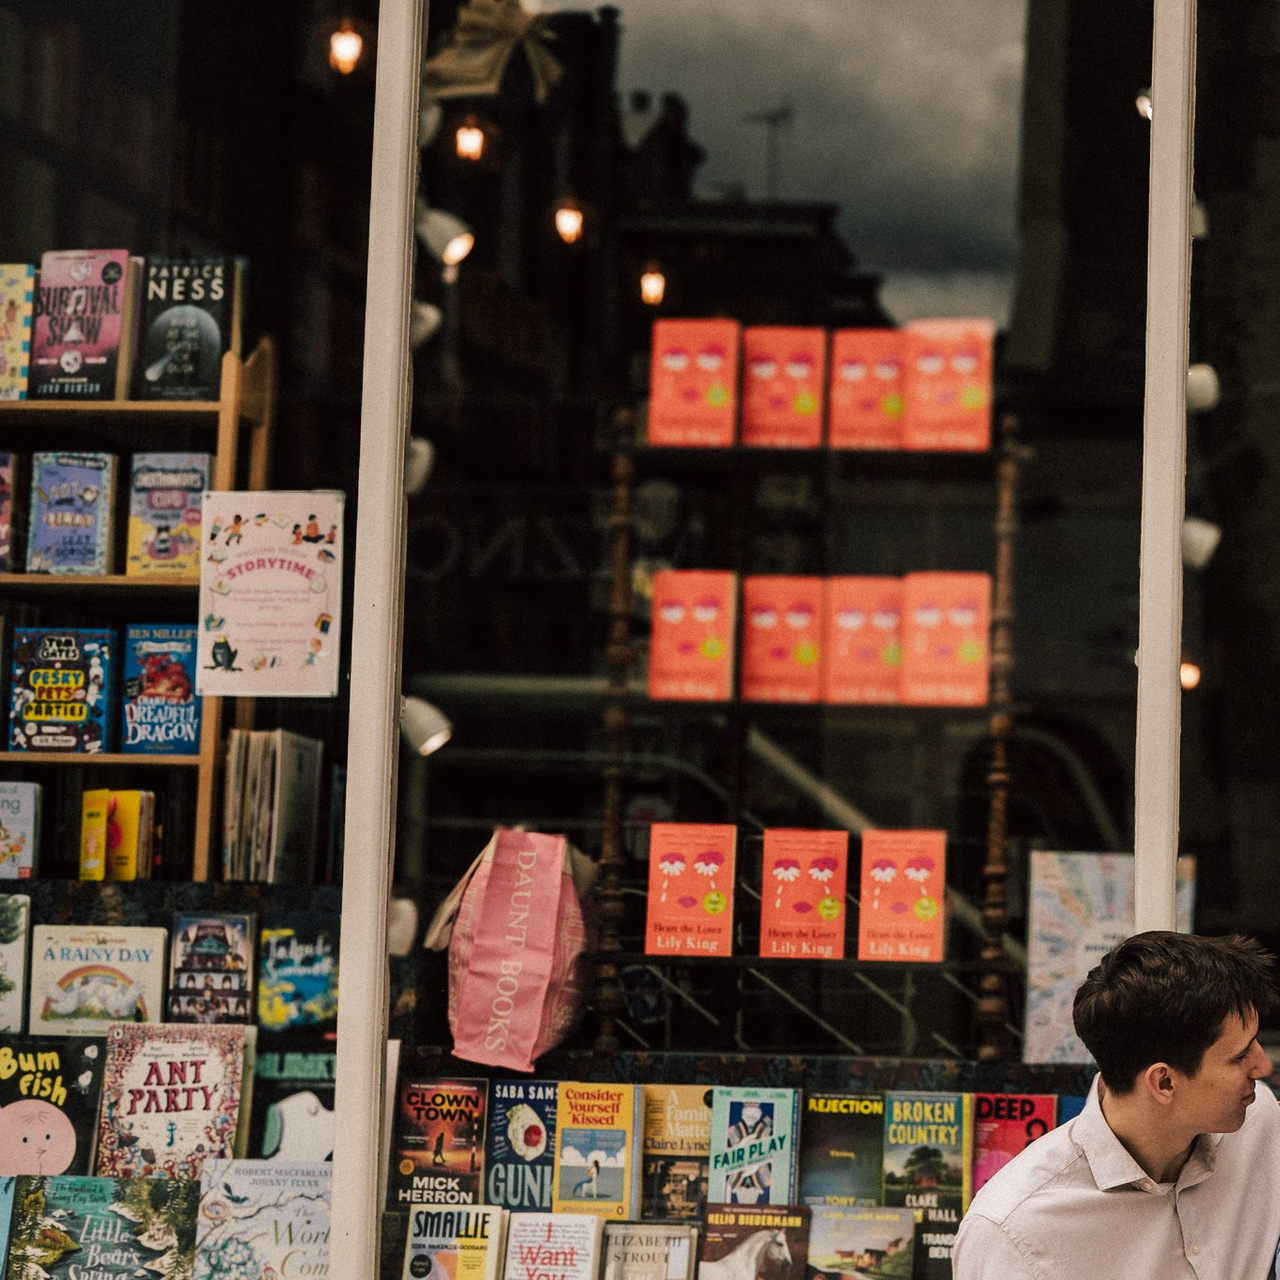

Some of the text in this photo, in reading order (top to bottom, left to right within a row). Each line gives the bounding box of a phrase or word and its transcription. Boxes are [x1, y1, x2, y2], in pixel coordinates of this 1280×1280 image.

[149, 265, 224, 278] PATRICK
[148, 278, 225, 301] NESS
[225, 558, 315, 580] STORYTIME
[41, 647, 77, 659] GATES
[32, 671, 82, 685] PESKY
[37, 686, 75, 700] PETS
[24, 704, 85, 718] PARTIES
[125, 703, 196, 723] DREADFUL
[126, 719, 199, 745] DRAGON
[484, 851, 538, 1053] DAUNT BOOKS
[657, 935, 718, 954] Lily King
[771, 941, 833, 958] Lily King
[869, 941, 931, 959] Lily King
[44, 946, 153, 963] A RAINY DAY
[0, 1046, 61, 1080] Bum
[144, 1060, 206, 1087] ANT
[406, 1091, 480, 1109] CLOWN
[495, 1084, 525, 1099] SABA
[565, 1089, 624, 1102] Consider
[668, 1089, 679, 1106] A
[127, 1086, 217, 1116] PARTY
[568, 1101, 621, 1114] Yourself
[808, 1098, 884, 1115] REJECTION
[975, 1096, 1035, 1120] DEEP
[413, 1107, 474, 1123] TOWN
[571, 1113, 616, 1126] Kissed
[892, 1101, 956, 1122] BROKEN
[643, 1137, 677, 1150] Claire
[888, 1124, 960, 1146] COUNTRY
[713, 1147, 745, 1170] FAIR
[748, 1134, 787, 1159] PLAY
[234, 1168, 272, 1176] ROBERT
[250, 1178, 320, 1187] JOHNNY FLYNN
[412, 1176, 460, 1190] MICK
[398, 1189, 473, 1204] HERRON
[824, 1195, 856, 1206] TONY
[905, 1193, 938, 1208] CLARE
[295, 1207, 316, 1218] The
[707, 1213, 802, 1228] NELIO BIEDERMANN
[928, 1208, 958, 1223] HALL
[79, 1214, 130, 1244] Little
[412, 1210, 491, 1239] SMALLIE
[543, 1221, 553, 1243] I
[605, 1235, 682, 1248] ELIZABETH
[85, 1247, 142, 1268] Bear's
[518, 1244, 578, 1267] Want
[613, 1252, 669, 1264] STROUT
